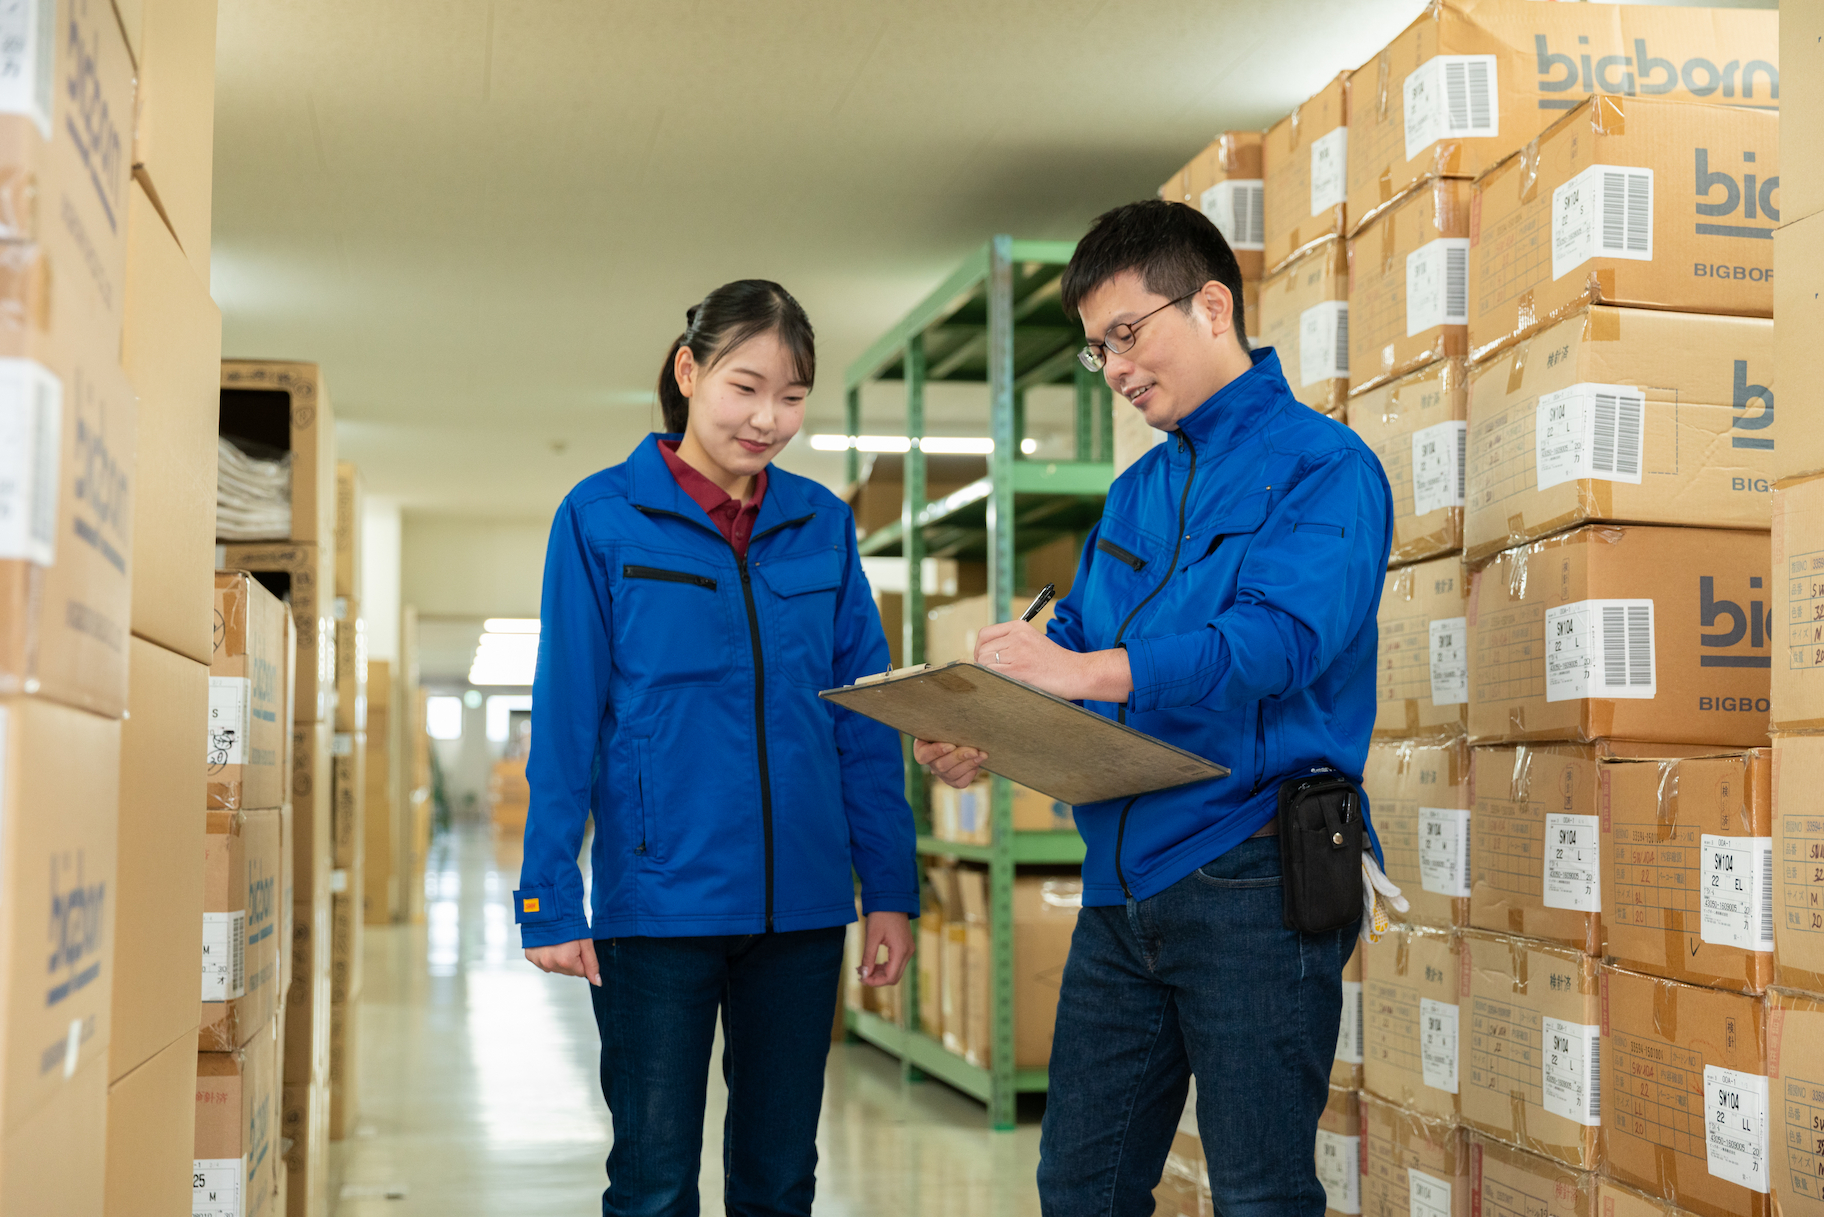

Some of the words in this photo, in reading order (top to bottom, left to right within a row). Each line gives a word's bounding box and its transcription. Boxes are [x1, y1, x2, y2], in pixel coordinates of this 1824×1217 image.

[1534, 34, 1779, 99] bigborn
[1732, 477, 1769, 493] BIG
[1700, 576, 1772, 648] bi
[1557, 619, 1573, 636] SW104
[1699, 697, 1770, 712] BIGBO
[212, 709, 218, 718] S
[1722, 786, 1730, 827] 検済
[1559, 829, 1576, 845] SW104
[1715, 853, 1733, 872] SW104
[1640, 869, 1651, 884] 22
[1711, 875, 1719, 887] 22
[1735, 878, 1743, 891] EL
[1810, 892, 1818, 906] M
[1635, 910, 1644, 923] 20
[203, 945, 210, 955] M
[1640, 1082, 1650, 1098] 22
[1719, 1089, 1739, 1111] SW104
[1716, 1110, 1725, 1124] 22
[1742, 1118, 1751, 1131] LL
[1788, 1106, 1800, 1121] 品番
[1635, 1121, 1644, 1135] 20
[1789, 1129, 1802, 1145] 色番
[1791, 1153, 1811, 1168] サイズ
[209, 1192, 216, 1202] M
